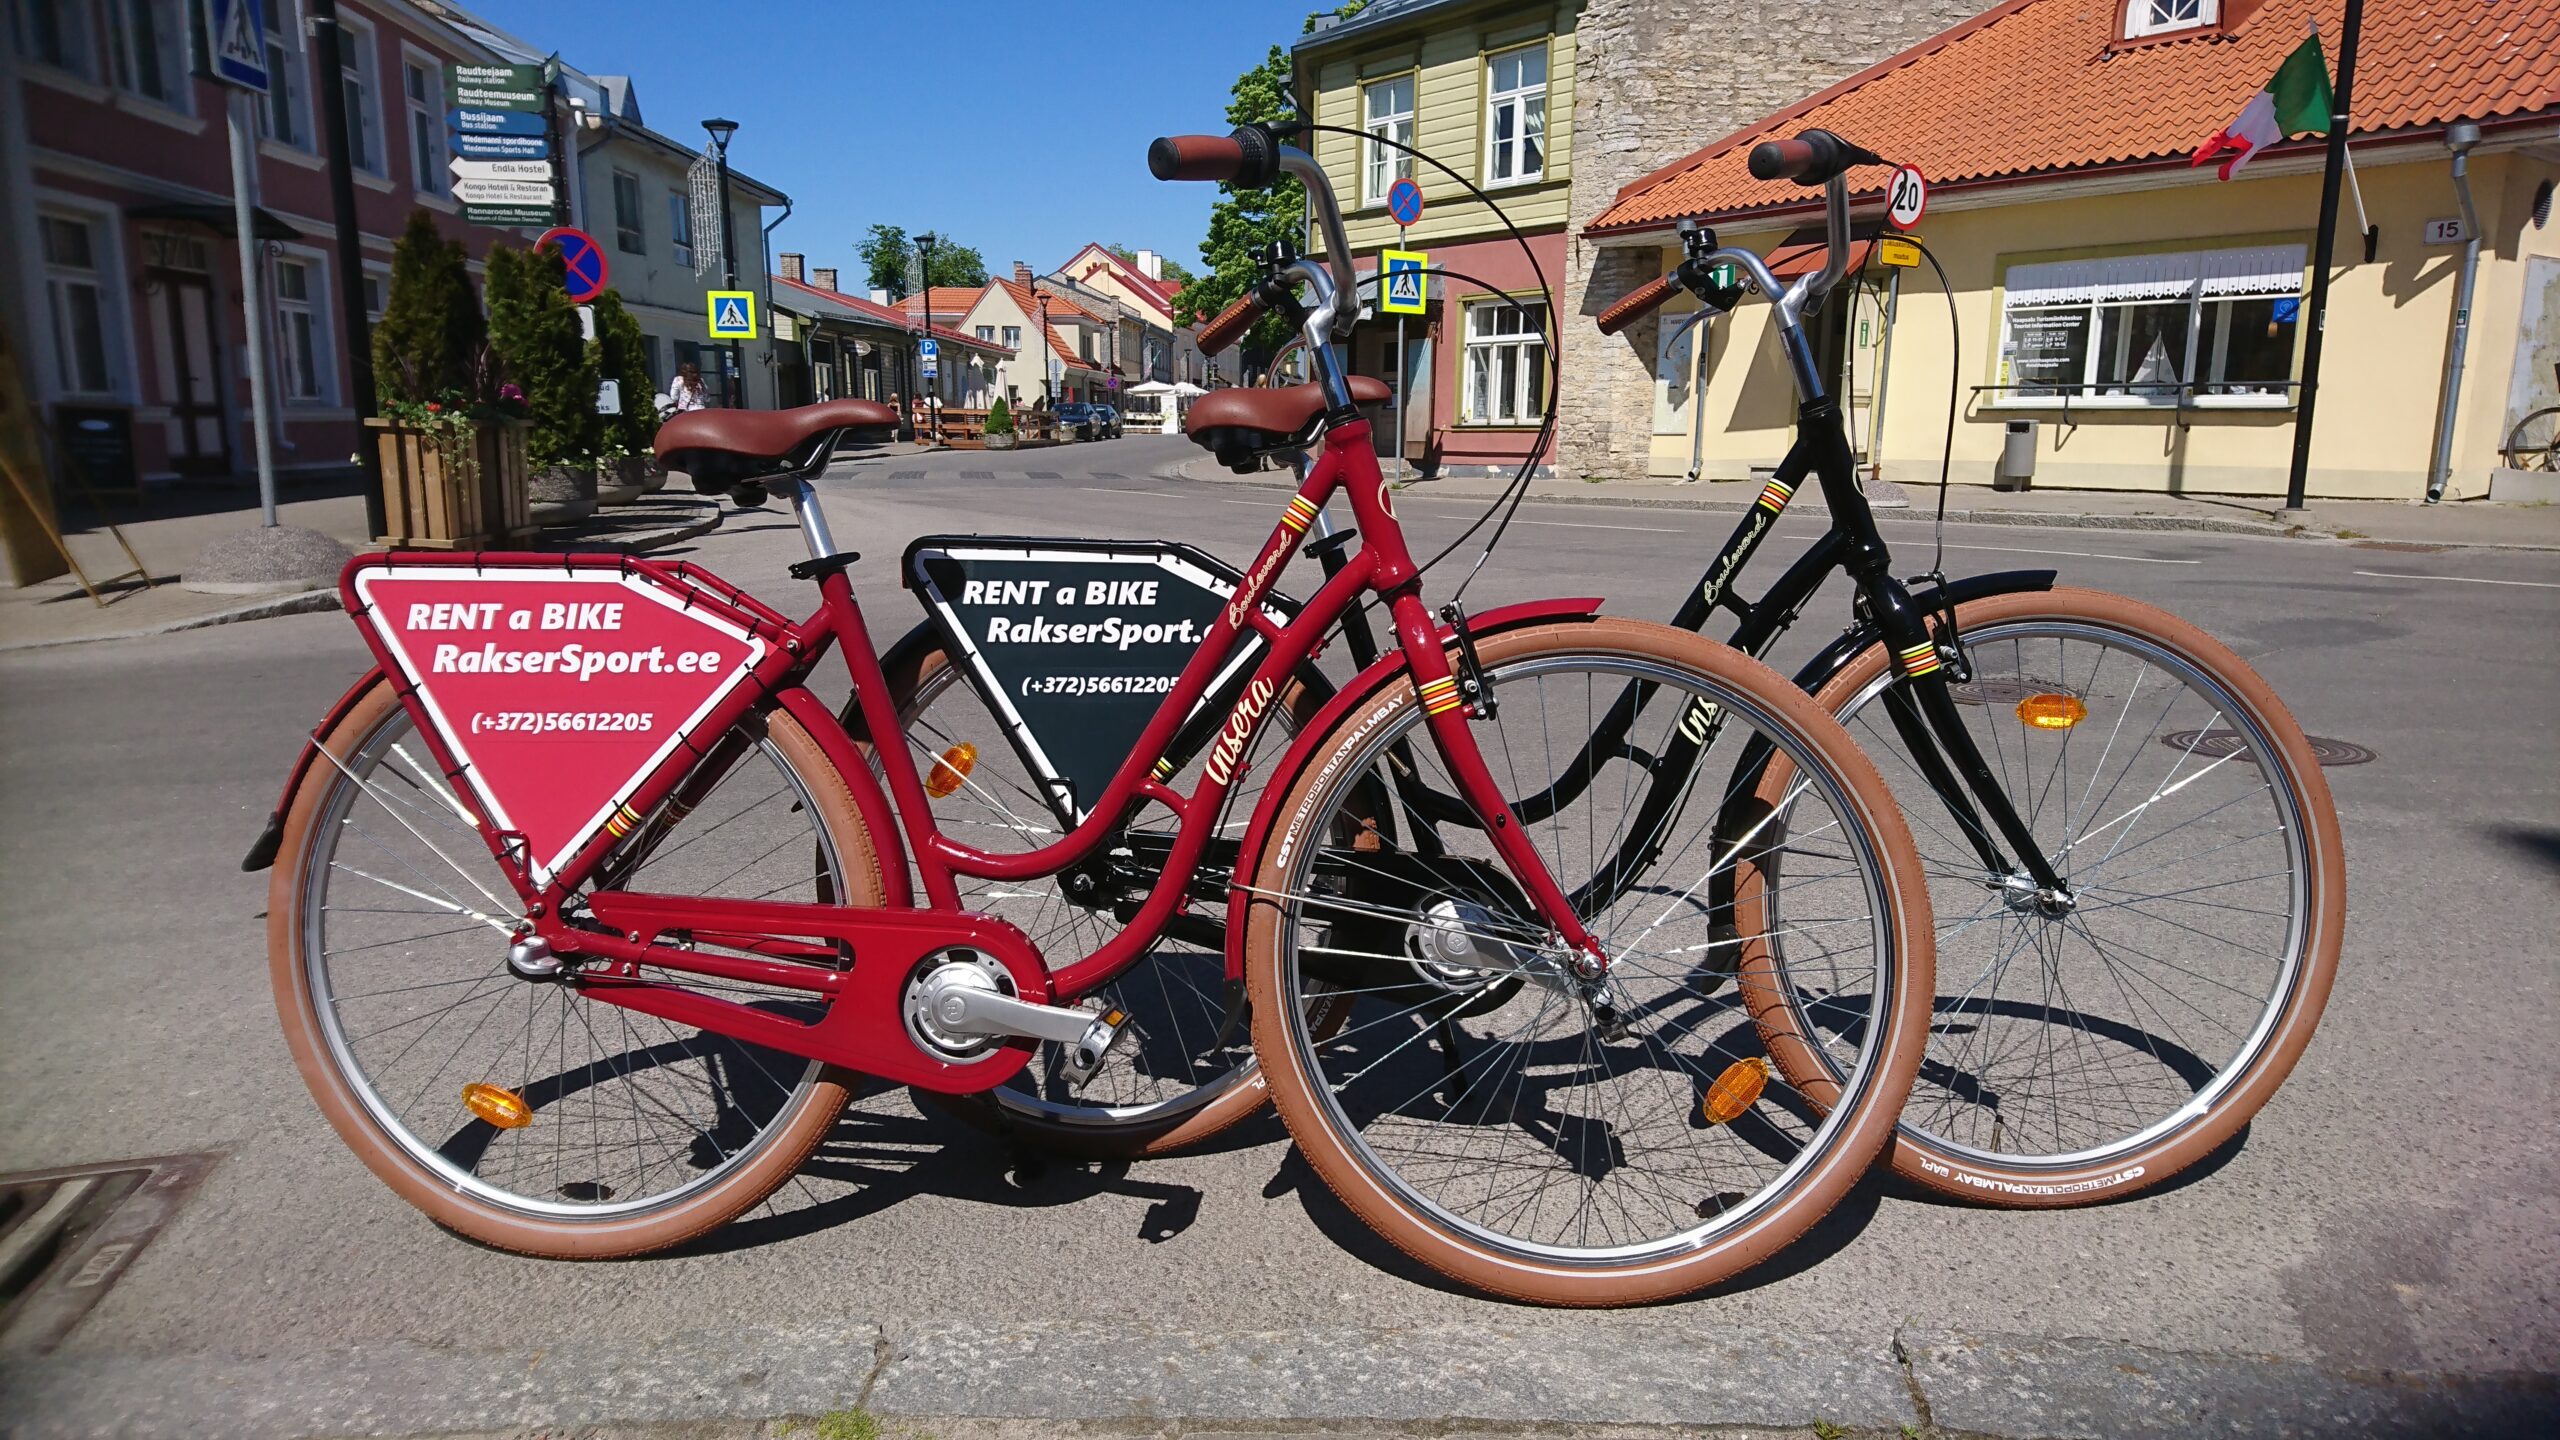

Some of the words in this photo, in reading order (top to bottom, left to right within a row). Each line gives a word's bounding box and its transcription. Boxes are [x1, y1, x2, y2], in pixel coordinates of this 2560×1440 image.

[456, 65, 513, 77] Raudteejaam
[457, 75, 481, 84] Railway
[483, 76, 505, 84] station
[457, 87, 535, 101] Raudteemuuseum
[458, 96, 482, 106] Railway
[484, 98, 510, 107] Museum
[460, 110, 504, 123] Bussijaam
[461, 120, 473, 129] Bus
[474, 121, 497, 130] station
[461, 135, 502, 145] Wiedemanni
[463, 144, 500, 153] Wiedemanni
[501, 146, 521, 154] Sports
[522, 146, 535, 154] Hall
[491, 163, 516, 173] Endla
[518, 164, 545, 174] Hostel
[463, 182, 486, 192] Kongo
[487, 183, 509, 191] Hotell
[516, 184, 548, 192] Restoran
[465, 192, 485, 200] Kongo
[509, 193, 542, 201] Restaurant
[1896, 181, 1919, 212] 20
[467, 206, 513, 217] Rannarootsi
[514, 208, 551, 218] Muuseum
[2437, 221, 2459, 239] 15
[1704, 512, 1767, 606] Boulevard
[1229, 529, 1292, 630] Boulevard
[963, 580, 1050, 605] RENT
[1055, 586, 1077, 606] a
[1084, 580, 1160, 606] BIKE
[406, 603, 504, 630] RENT
[508, 609, 532, 631] a
[540, 602, 624, 630] BIKE
[986, 616, 1215, 651] RakserSport.
[432, 642, 722, 682] RakserSport.ee
[470, 711, 654, 735] (+372)56612205
[1275, 831, 1298, 869] CST
[1919, 1156, 1942, 1174] APL
[2112, 1165, 2146, 1184] CST
